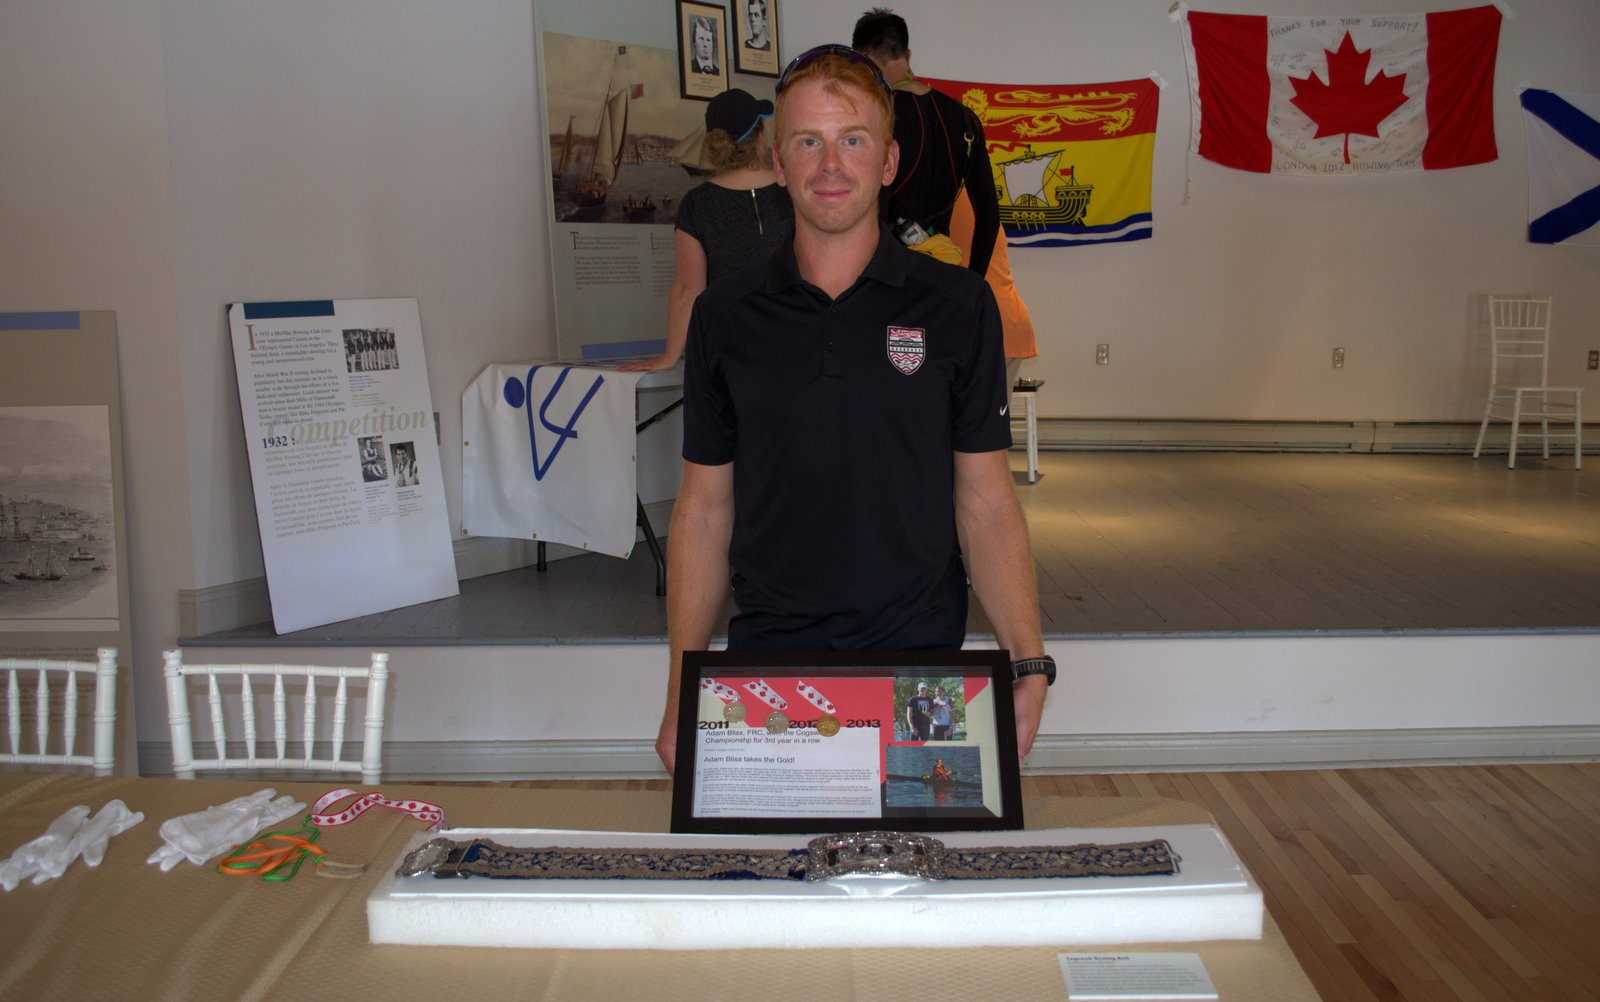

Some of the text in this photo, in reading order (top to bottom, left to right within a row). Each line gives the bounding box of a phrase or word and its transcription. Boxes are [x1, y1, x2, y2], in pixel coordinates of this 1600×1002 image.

[1269, 18, 1419, 37] THANKS FOR YOUR SUPPORT!
[1322, 162, 1345, 172] 2012
[1352, 161, 1390, 171] ROWING
[1395, 158, 1416, 168] TEAM
[266, 407, 427, 447] Competition
[262, 436, 289, 449] 1932
[699, 719, 881, 730] 2011 2012 2013
[763, 756, 776, 764] the
